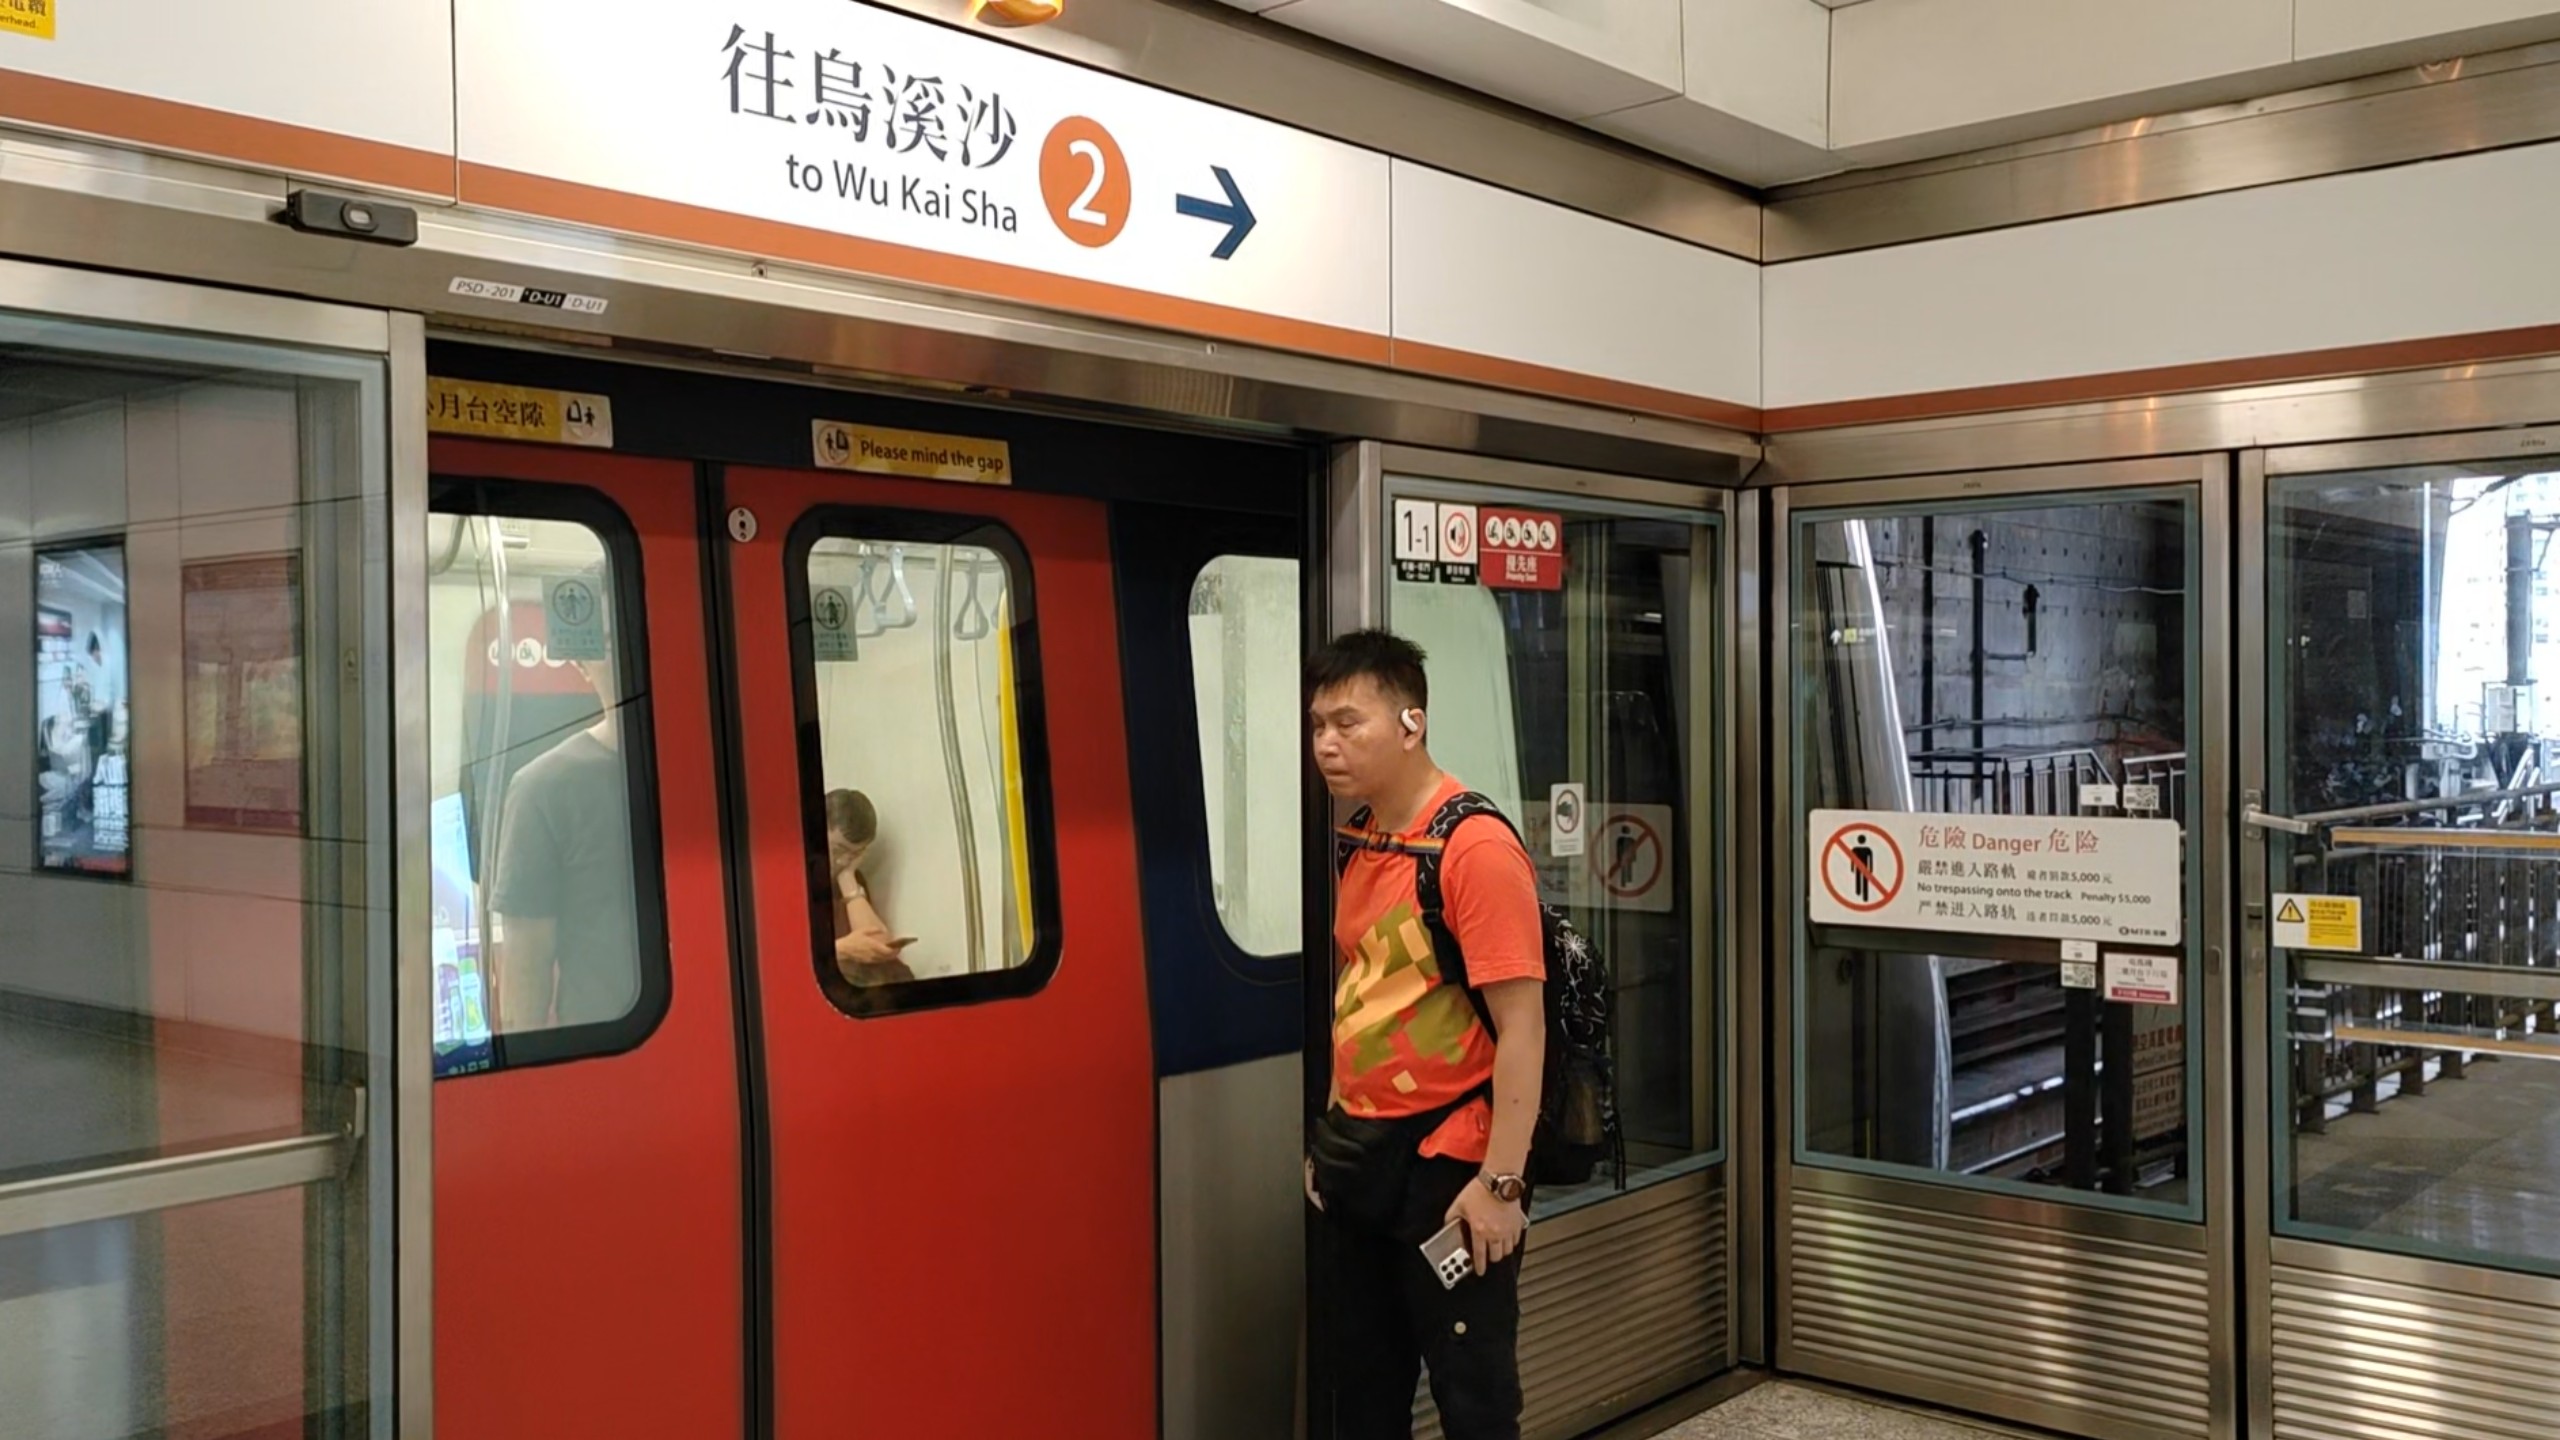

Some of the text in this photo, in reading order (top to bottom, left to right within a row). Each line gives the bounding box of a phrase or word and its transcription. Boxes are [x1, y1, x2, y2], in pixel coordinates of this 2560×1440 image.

[721, 23, 1017, 168] 往烏溪沙
[786, 155, 1018, 233] to Wu Kai Sha
[1067, 139, 1108, 226] 2
[860, 439, 1004, 472] Please mind the gap
[1919, 825, 1966, 850] 危險
[1972, 833, 2041, 855] Danger
[1917, 882, 1932, 893] No
[1934, 883, 1994, 899] trespassing
[1996, 887, 2021, 897] onto
[2023, 887, 2042, 898] the
[2044, 889, 2072, 900] track
[2081, 891, 2116, 904] Penalty
